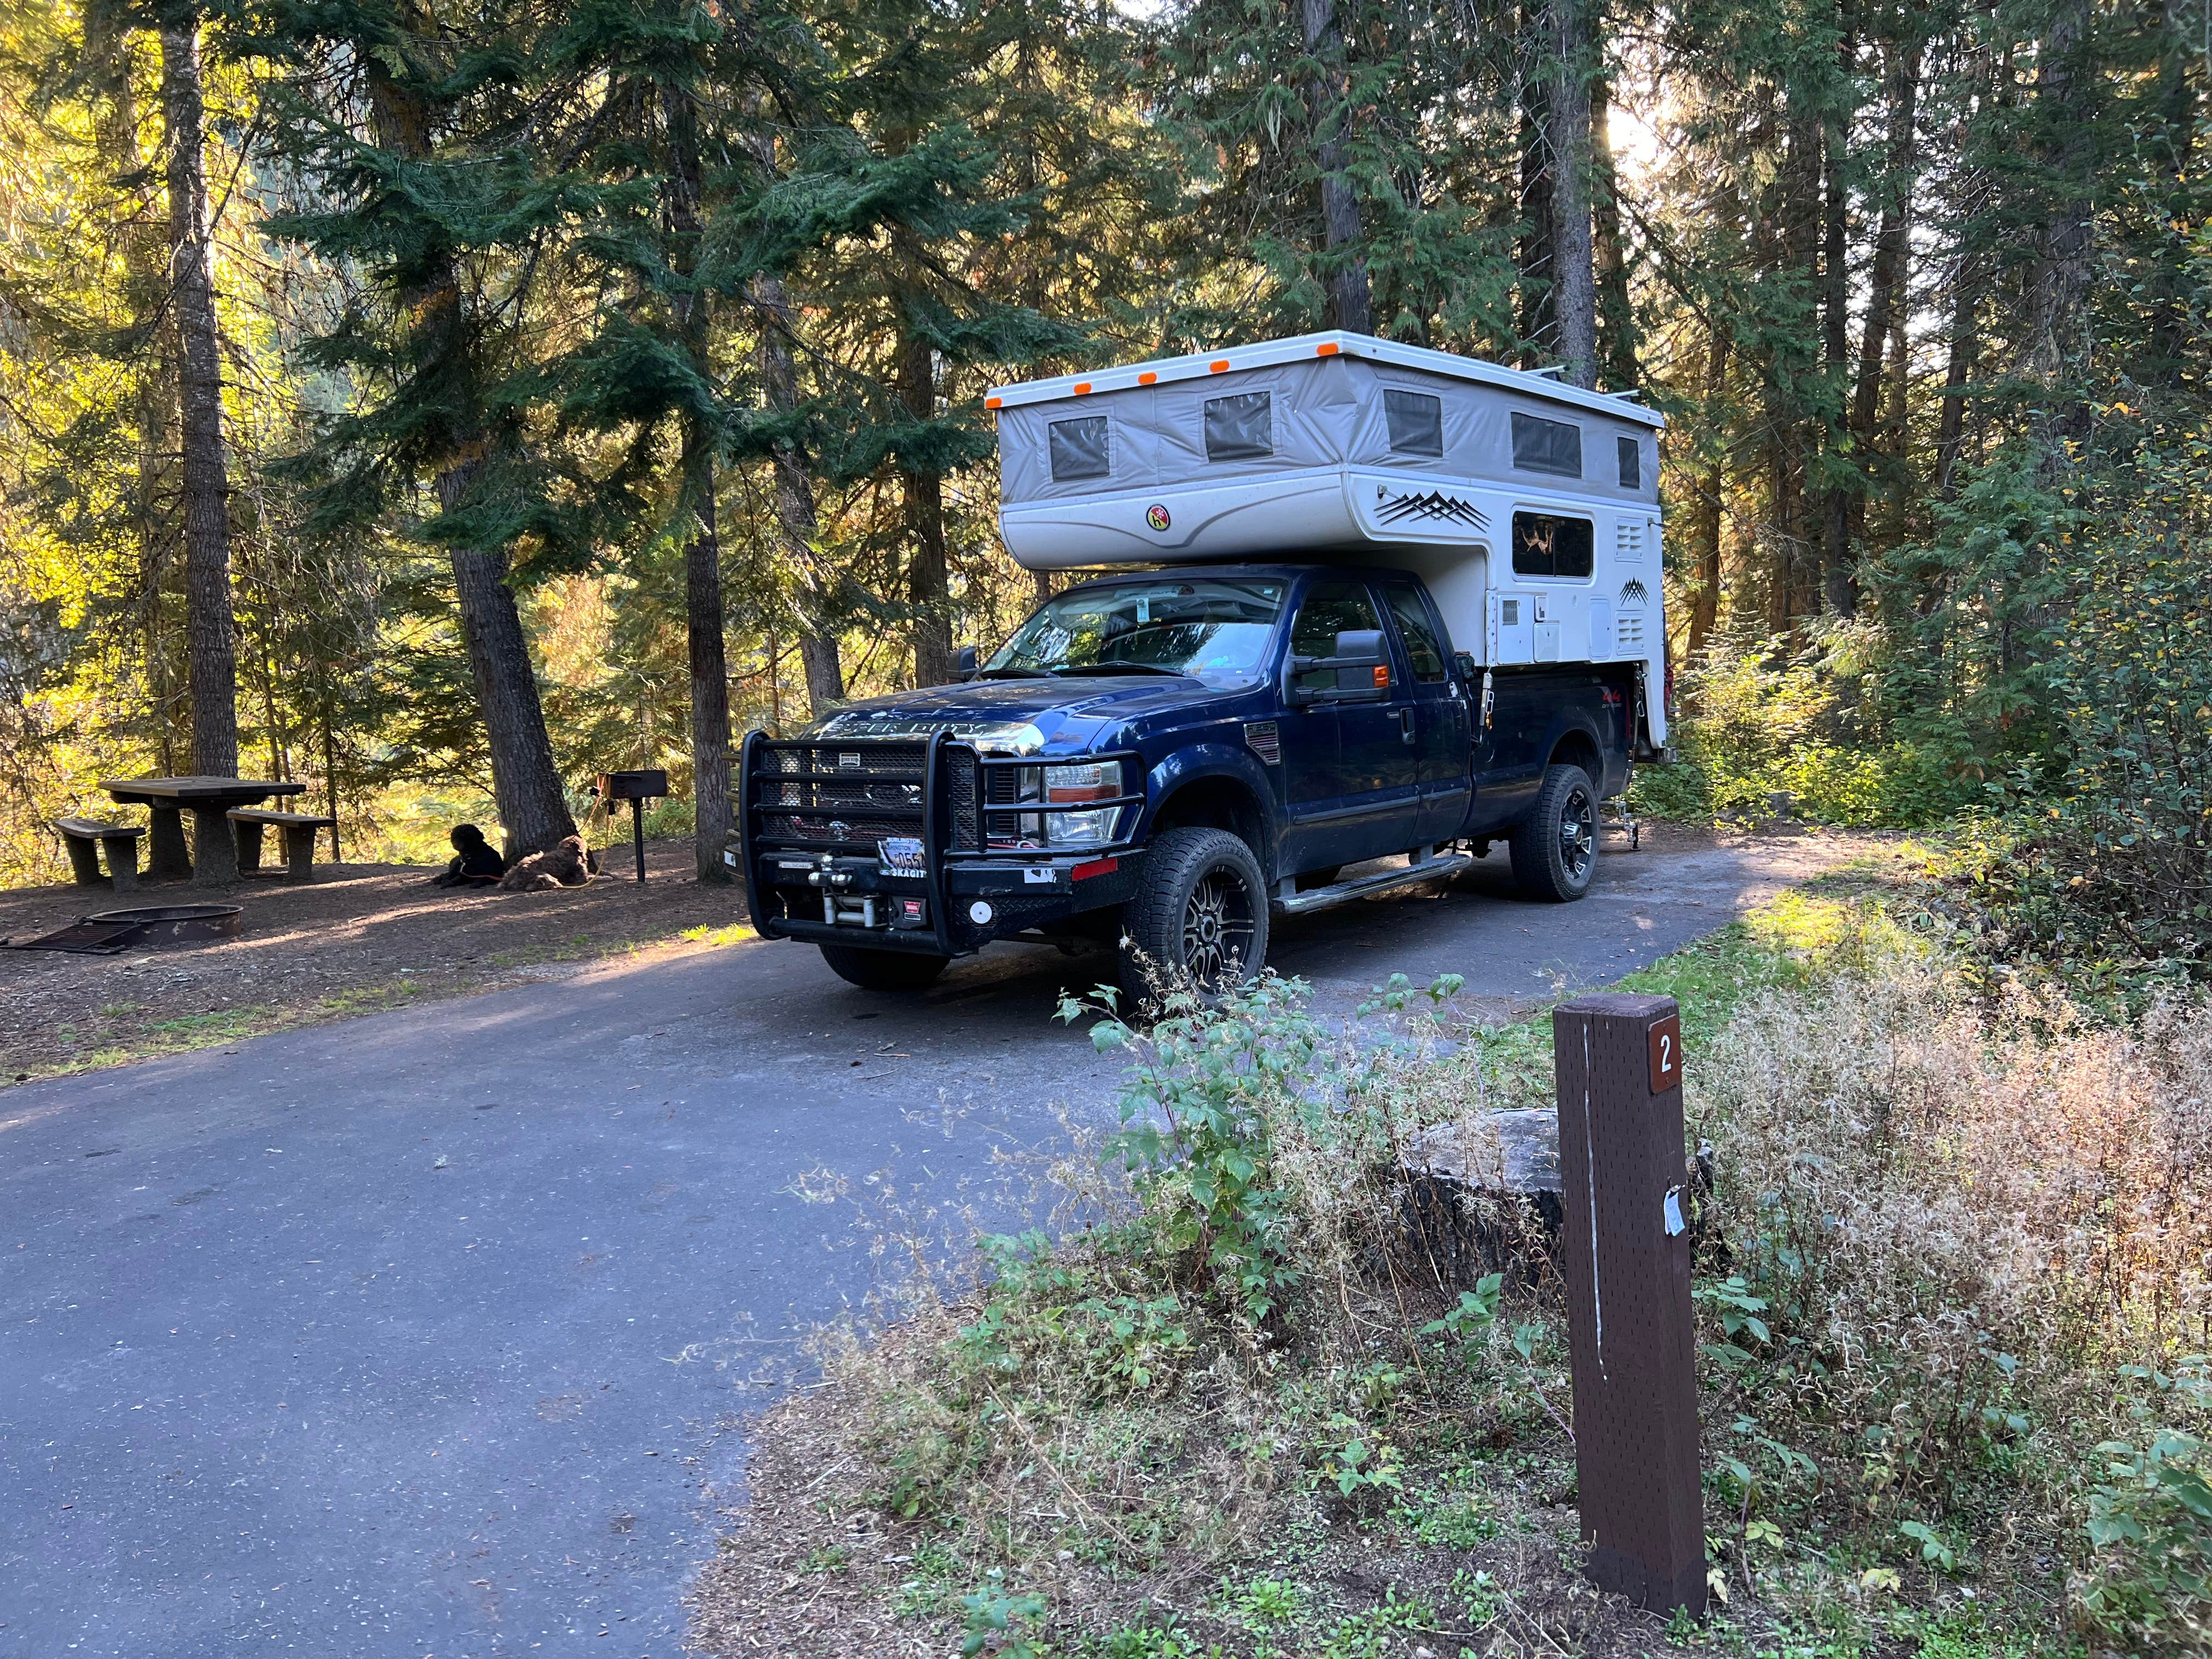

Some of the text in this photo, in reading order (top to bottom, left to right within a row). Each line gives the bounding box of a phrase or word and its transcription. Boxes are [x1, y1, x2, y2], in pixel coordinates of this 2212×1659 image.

[826, 723, 987, 733] SUPER DUTY
[891, 869, 926, 878] SKAGIT
[1660, 1035, 1672, 1073] 2
